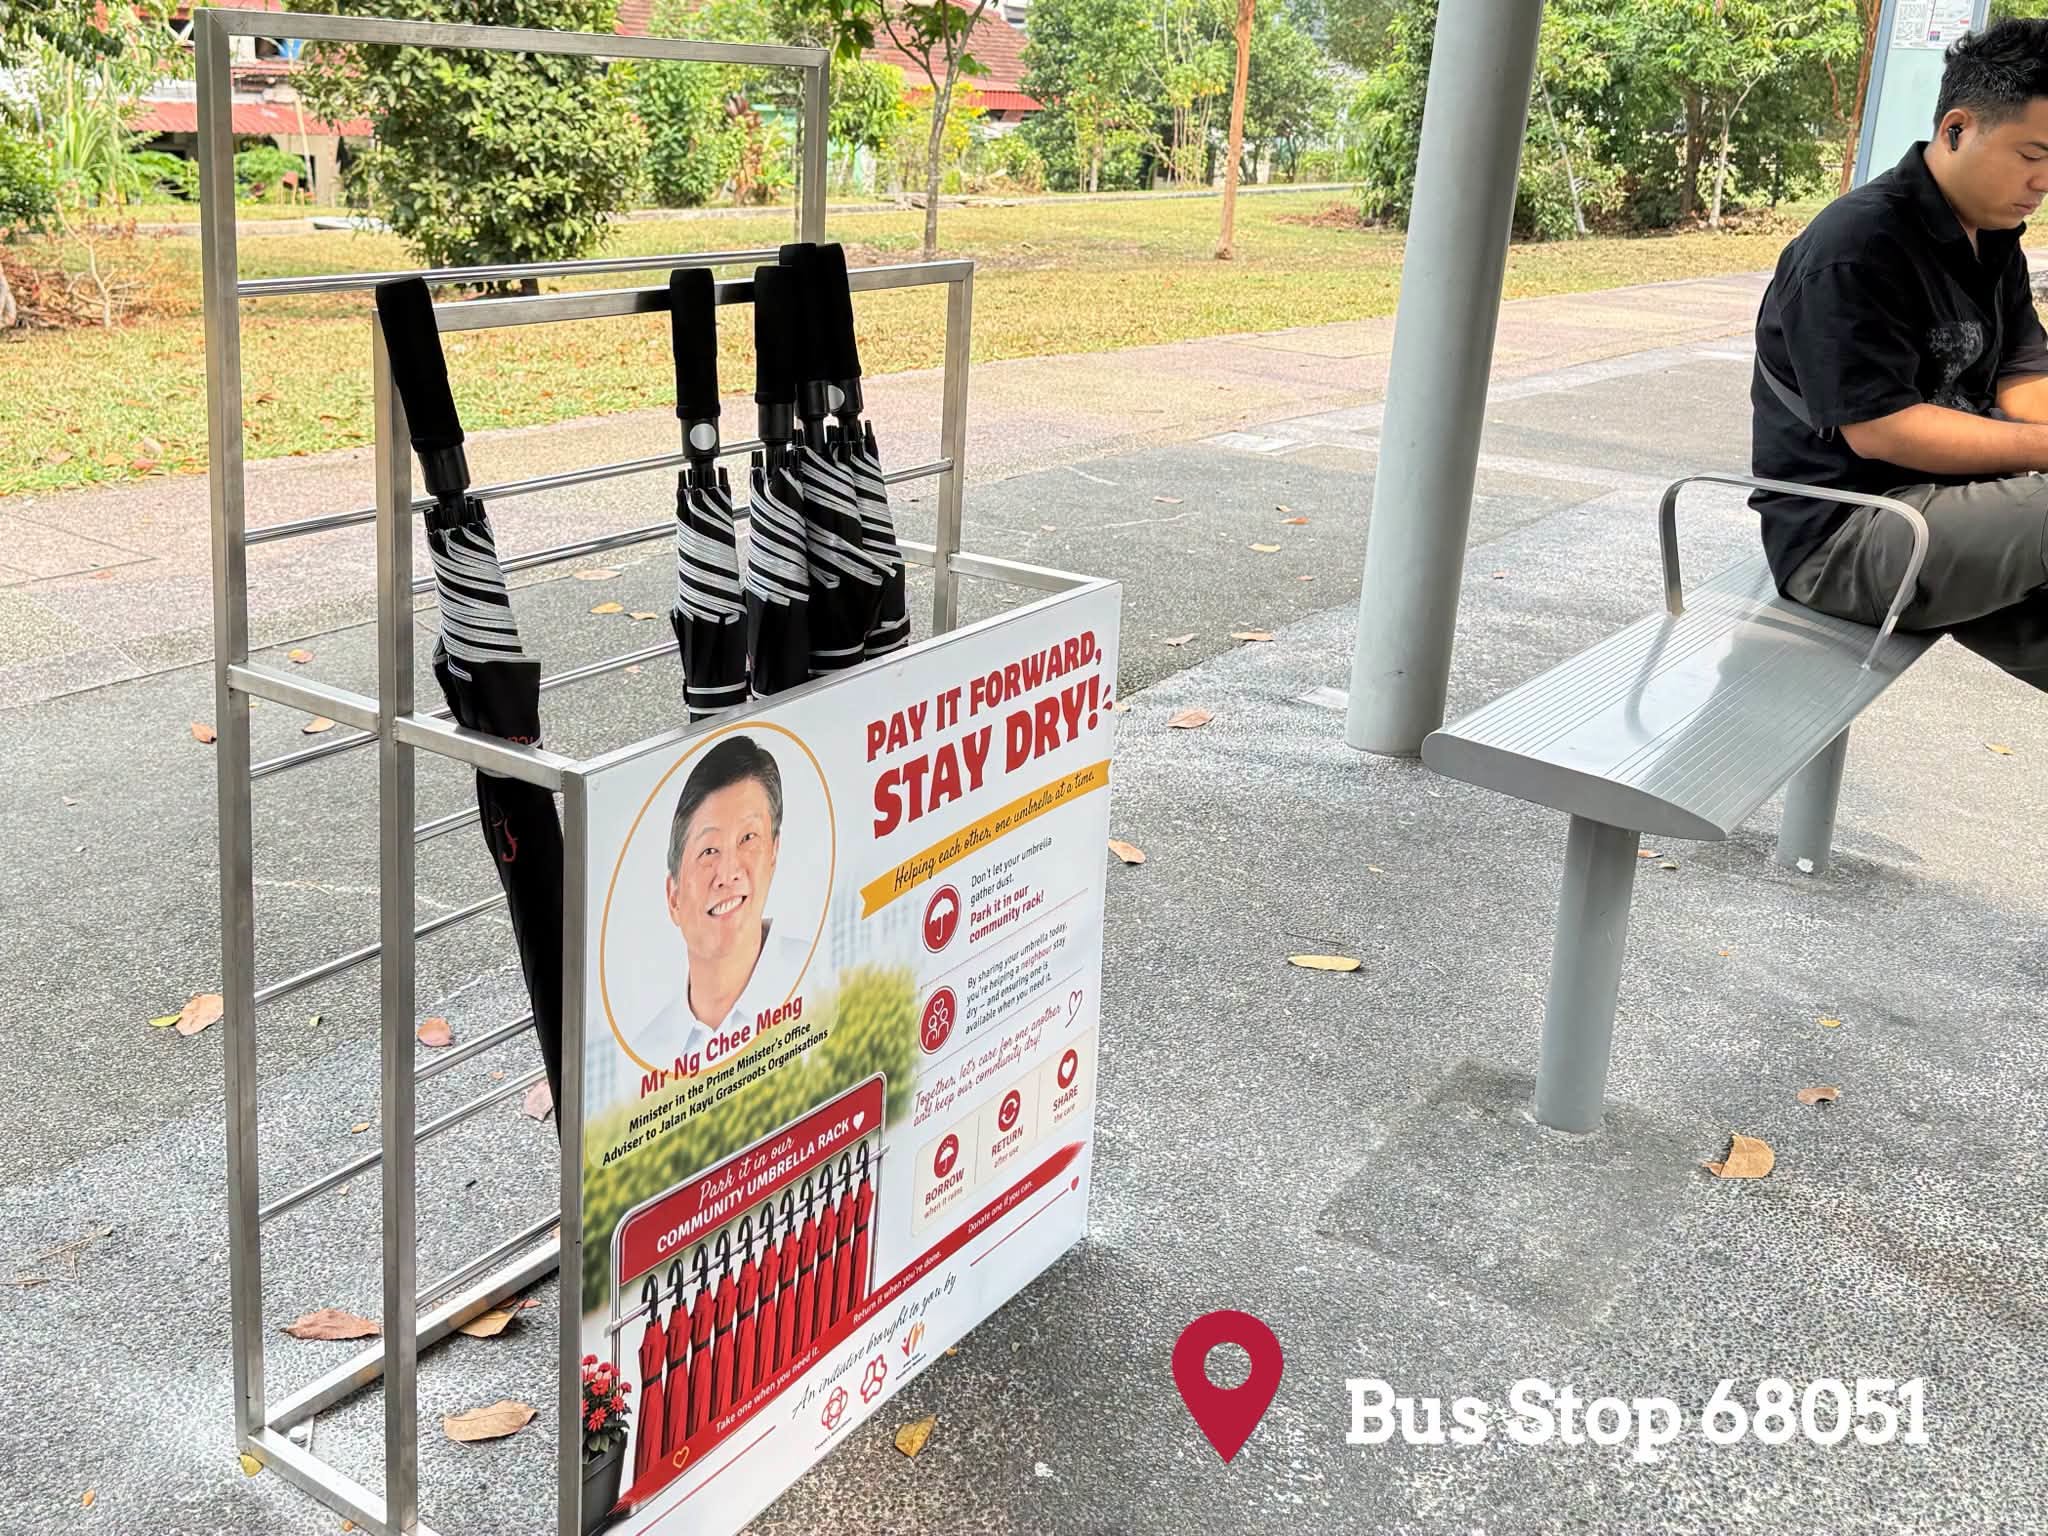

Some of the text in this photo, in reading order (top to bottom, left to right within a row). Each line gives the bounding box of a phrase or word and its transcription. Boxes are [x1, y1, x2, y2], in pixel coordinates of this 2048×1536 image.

[867, 630, 1101, 762] PAY IT FORWARD,
[874, 673, 1100, 839] STAY DRY!
[894, 858, 936, 892] Helping
[938, 838, 961, 864] each
[995, 817, 1013, 832] one
[1014, 793, 1053, 823] umbrella
[1054, 784, 1066, 797] at
[1066, 783, 1073, 793] a
[1074, 769, 1095, 790] time.
[971, 836, 1052, 887] Don't let your umbrella
[969, 889, 1044, 944] community rack!
[970, 872, 1014, 907] gather dust.
[970, 884, 1030, 926] Park it in our
[966, 985, 988, 1007] you're
[989, 970, 1014, 991] helping
[1020, 946, 1051, 971] neighbour
[1052, 936, 1066, 951] stay
[966, 1006, 978, 1020] dry
[987, 993, 1000, 1006] and
[1000, 974, 1029, 997] ensuring
[1030, 967, 1041, 979] one
[1043, 960, 1048, 971] is
[967, 976, 977, 989] By
[978, 961, 1004, 983] sharing
[1004, 950, 1020, 969] your
[1020, 933, 1048, 956] umbrella
[965, 1007, 996, 1035] available
[997, 997, 1015, 1015] when
[1015, 988, 1028, 1004] you
[1029, 978, 1046, 994] need
[978, 1047, 998, 1067] care
[1014, 1026, 1029, 1043] one
[1031, 1004, 1061, 1031] another
[629, 1022, 811, 1134] Minister in the Prime Minister's Office
[640, 996, 803, 1098] Mr Ng Chee Meng
[913, 1029, 1042, 1127] and keep our community dry!
[602, 1028, 828, 1166] Adviser to Jalan Kayu Grassroots Organisations
[1052, 1085, 1079, 1111] SHARE
[991, 1125, 1024, 1157] RETURN
[656, 1118, 849, 1252] COMMUNITY UMBRELLA RACK
[698, 1136, 795, 1209] Park it in our
[925, 1168, 965, 1205] BORROW
[924, 1202, 941, 1218] when
[967, 1213, 991, 1234] Donate
[991, 1204, 1003, 1216] one
[1002, 1195, 1010, 1209] if
[1009, 1190, 1020, 1205] you
[853, 1301, 876, 1325] Return
[877, 1294, 883, 1305] it
[883, 1281, 902, 1300] when
[902, 1264, 923, 1287] you're
[792, 1384, 815, 1420] An
[818, 1346, 865, 1394] initiative
[866, 1305, 908, 1355] brought
[908, 1299, 920, 1319] to
[920, 1287, 942, 1317] you
[944, 1271, 957, 1295] by
[716, 1413, 736, 1433] Take
[737, 1400, 752, 1417] one
[753, 1383, 776, 1404] when
[776, 1370, 790, 1390] you
[792, 1350, 811, 1373] need
